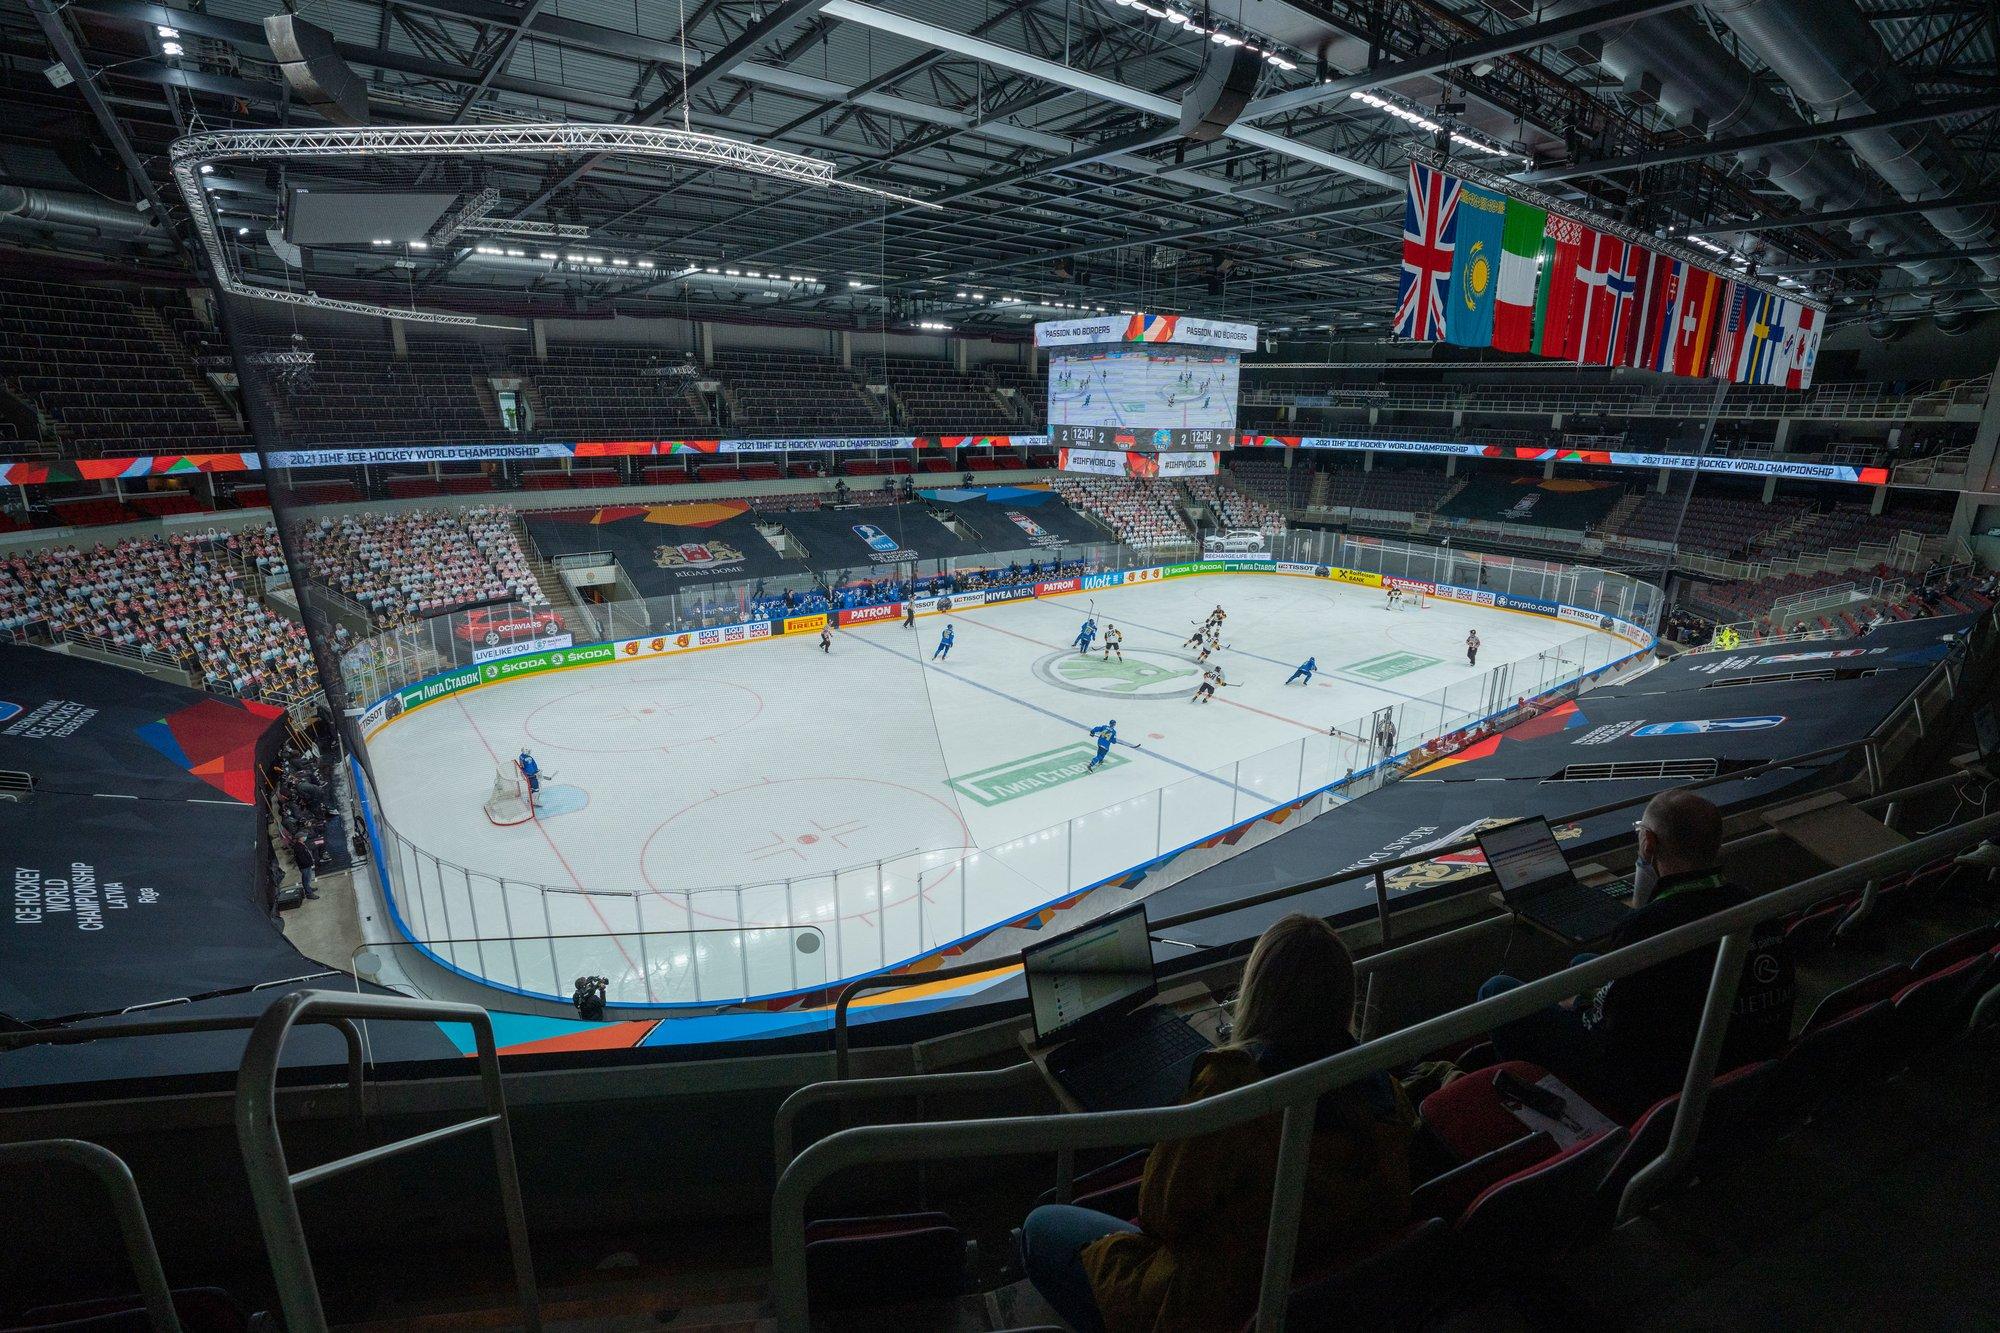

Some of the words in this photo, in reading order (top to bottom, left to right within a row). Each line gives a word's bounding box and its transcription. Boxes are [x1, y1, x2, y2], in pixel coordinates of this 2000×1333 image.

[1072, 328, 1081, 336] NO
[1082, 326, 1110, 336] BORDERS
[1213, 329, 1221, 338] NO
[1222, 330, 1248, 341] BORDERS
[1062, 430, 1068, 441] 2
[1072, 428, 1094, 440] 12:04
[1099, 433, 1104, 444] 2
[1181, 434, 1186, 445] 2
[1192, 430, 1212, 442] 12:04
[1216, 435, 1221, 445] 2
[737, 442, 755, 450] 2021
[756, 441, 772, 449] IIHF
[820, 440, 845, 448] WORLD
[846, 439, 899, 448] CHAMPIONSHIP
[1388, 442, 1413, 450] WORLD
[1415, 443, 1468, 453] CHAMPIONSHIP
[290, 454, 315, 465] 2021
[318, 452, 344, 464] IIHF
[346, 452, 366, 462] ICE
[370, 450, 414, 461] HOCKEY
[415, 448, 455, 459] WORLD
[458, 447, 540, 458] CHAMPIONSHIP
[1642, 456, 1661, 464] 2021
[1662, 457, 1679, 466] IIHF
[1681, 458, 1696, 467] ICE
[1698, 459, 1734, 469] HOCKEY
[1734, 461, 1764, 472] WORLD
[1766, 464, 1834, 477] CHAMPIONSHIP
[712, 566, 744, 574] DOME
[1288, 564, 1314, 572] TISSOT
[1044, 581, 1074, 591] PATRON
[1085, 576, 1111, 590] Wolt
[986, 592, 1012, 601] NIVEA
[1013, 588, 1034, 596] MEN
[851, 606, 891, 619] PATRON
[1509, 600, 1556, 614] crypto.com
[1573, 611, 1599, 620] TISSOT
[498, 623, 531, 632] OCTAVIA
[531, 621, 542, 629] RS
[700, 630, 718, 638] LIQUI
[725, 633, 744, 641] MOLY
[750, 629, 768, 637] MOLY
[700, 636, 719, 645] MOLY
[476, 652, 493, 660] LIVE
[495, 647, 512, 657] LIKE
[514, 644, 529, 653] YOU
[568, 649, 612, 661] ŠKODA
[502, 658, 547, 673] ŠKODA
[22, 726, 54, 738] ICE
[38, 700, 85, 728] HOCKEY
[362, 707, 383, 728] TISSOT
[15, 867, 41, 905] HOCKEY
[45, 879, 71, 912] WORLD
[72, 862, 104, 931] CHAMPIONSHIP
[104, 882, 128, 909] LATVIA
[15, 907, 42, 924] ICE
